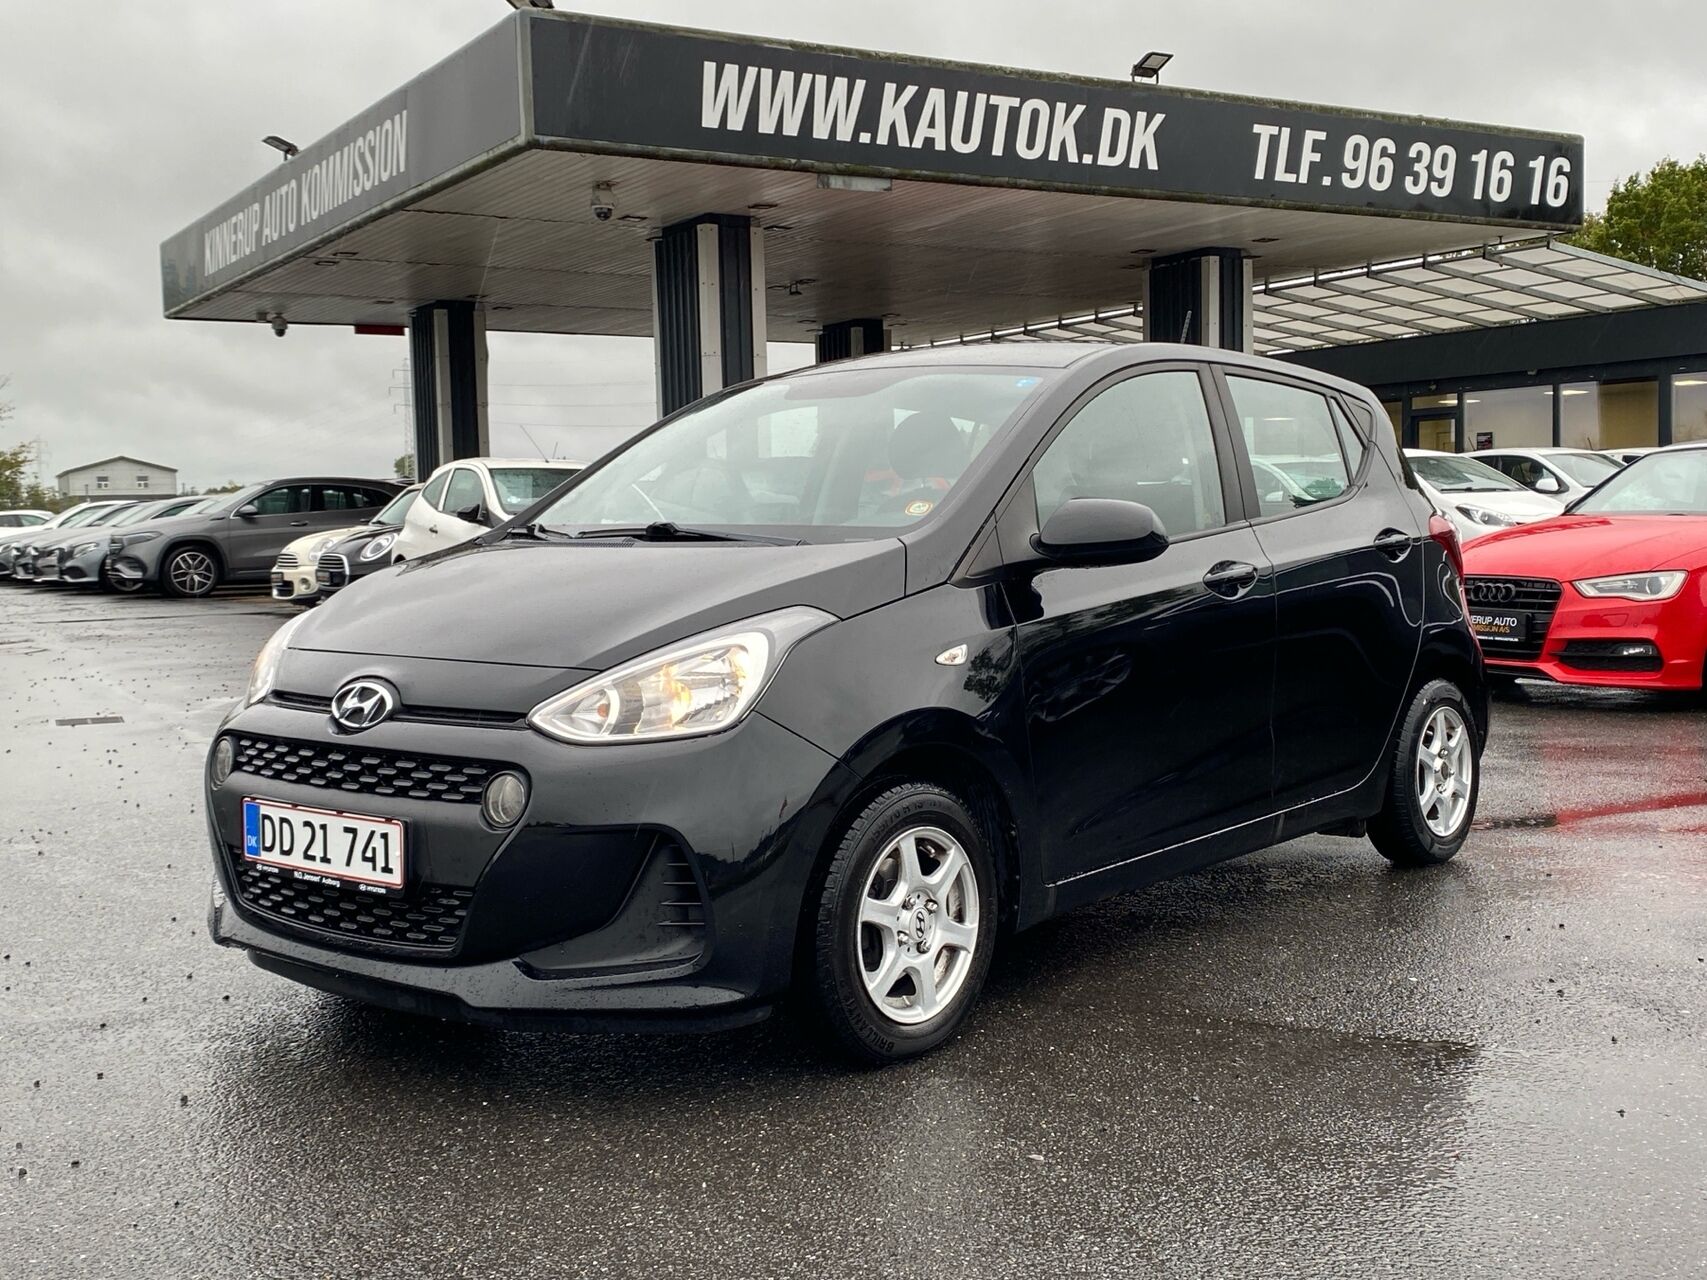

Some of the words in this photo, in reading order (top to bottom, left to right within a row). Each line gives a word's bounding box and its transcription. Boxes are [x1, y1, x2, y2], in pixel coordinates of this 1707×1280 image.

[701, 61, 1166, 170] WWW.KAUTOK.DK
[204, 202, 260, 277] KINNERUP
[262, 178, 298, 247] AUTO
[301, 109, 408, 226] KOMMISSION
[1252, 123, 1332, 186] TLF.
[1341, 134, 1396, 192] 96
[1404, 141, 1457, 198] 39
[1471, 149, 1515, 202] 16
[1529, 155, 1571, 207] 16
[1471, 615, 1493, 625] ERUP
[1493, 617, 1518, 627] AUTO
[247, 835, 257, 847] DK
[261, 813, 295, 857] DD
[302, 820, 332, 865] 21
[343, 826, 394, 875] 741
